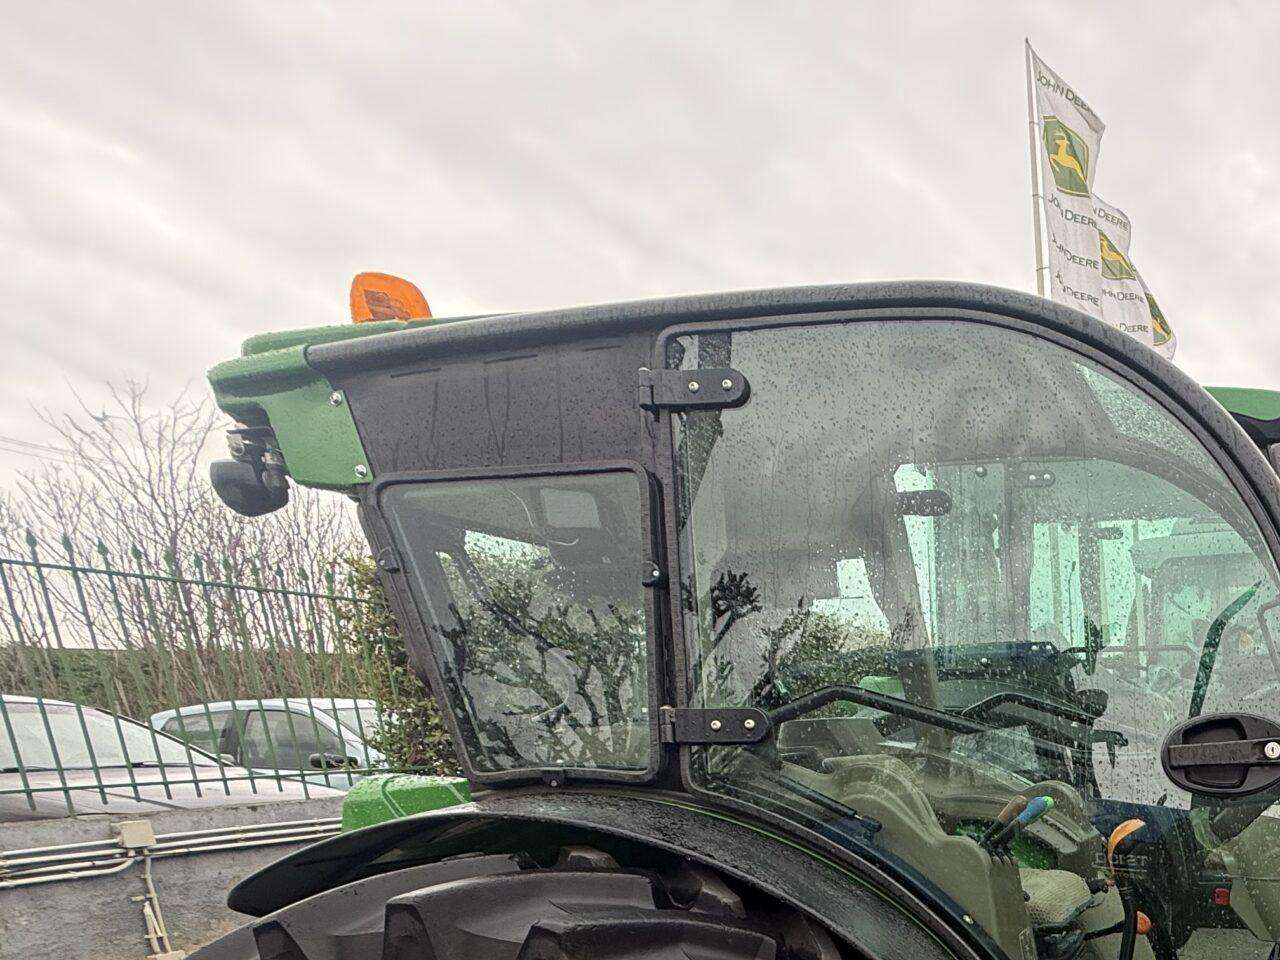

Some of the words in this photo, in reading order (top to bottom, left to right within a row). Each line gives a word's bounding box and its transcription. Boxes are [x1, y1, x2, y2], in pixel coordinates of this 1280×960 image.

[1037, 71, 1065, 96] JOHN
[1098, 208, 1129, 231] DEERE
[1065, 250, 1100, 269] DEERE
[1119, 322, 1148, 333] DEERE
